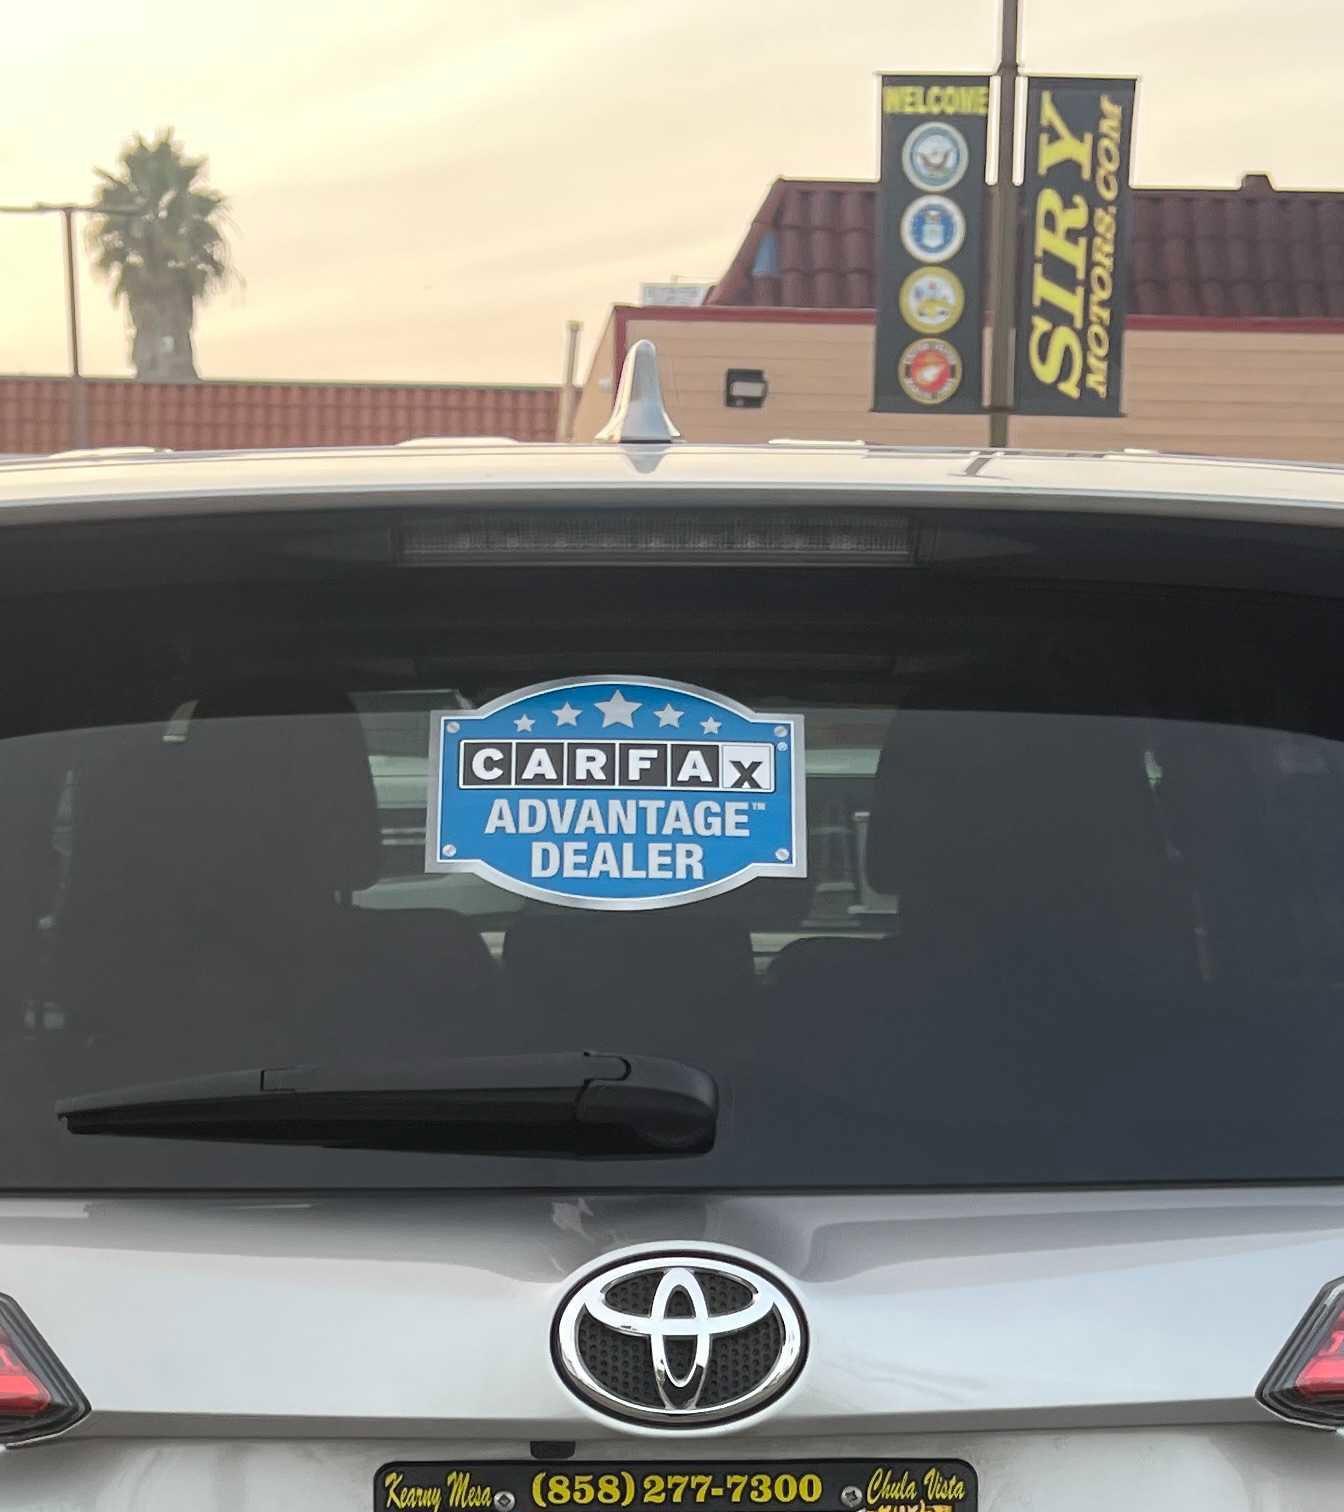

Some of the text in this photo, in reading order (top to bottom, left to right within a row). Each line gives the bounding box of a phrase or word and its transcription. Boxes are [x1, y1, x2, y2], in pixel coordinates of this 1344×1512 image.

[882, 85, 989, 116] WELCOME
[1029, 90, 1093, 399] SIRY
[471, 747, 763, 790] CARFAX
[484, 799, 751, 838] ADVANTAGE
[531, 842, 704, 881] DEALER
[447, 1471, 493, 1509] Mesa
[532, 1471, 823, 1508] (858) 277-7300
[867, 1467, 966, 1505] Chula Vista
